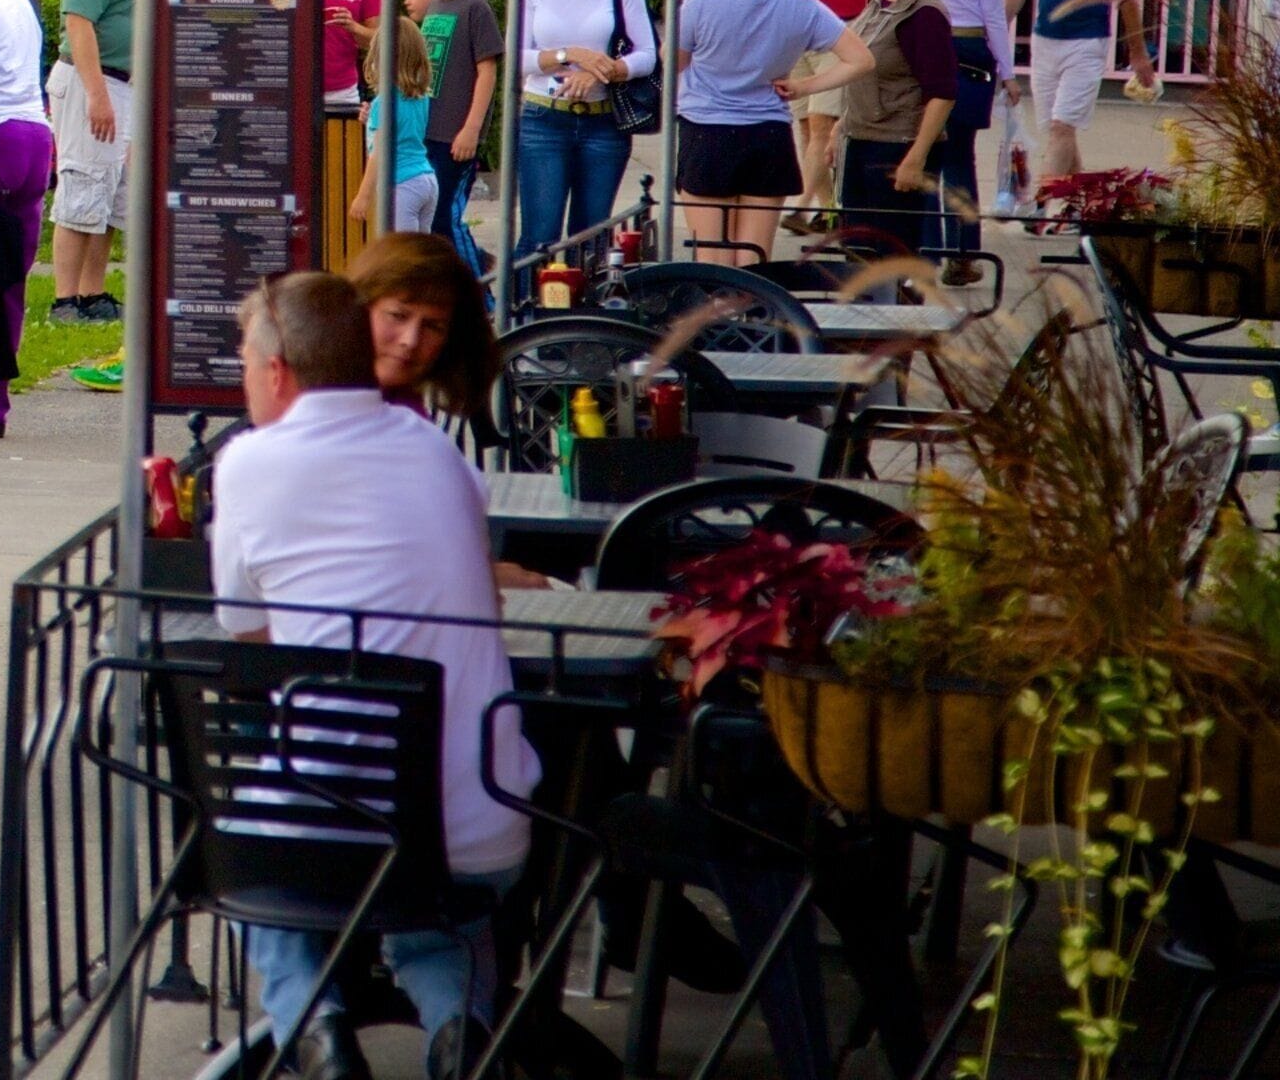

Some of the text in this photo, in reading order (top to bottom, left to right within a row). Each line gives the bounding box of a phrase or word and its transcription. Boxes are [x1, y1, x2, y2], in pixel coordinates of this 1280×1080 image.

[210, 92, 255, 102] DINNERS
[189, 196, 276, 208] HOT SANDWICHES
[180, 304, 202, 313] COLD
[203, 304, 223, 313] DELI
